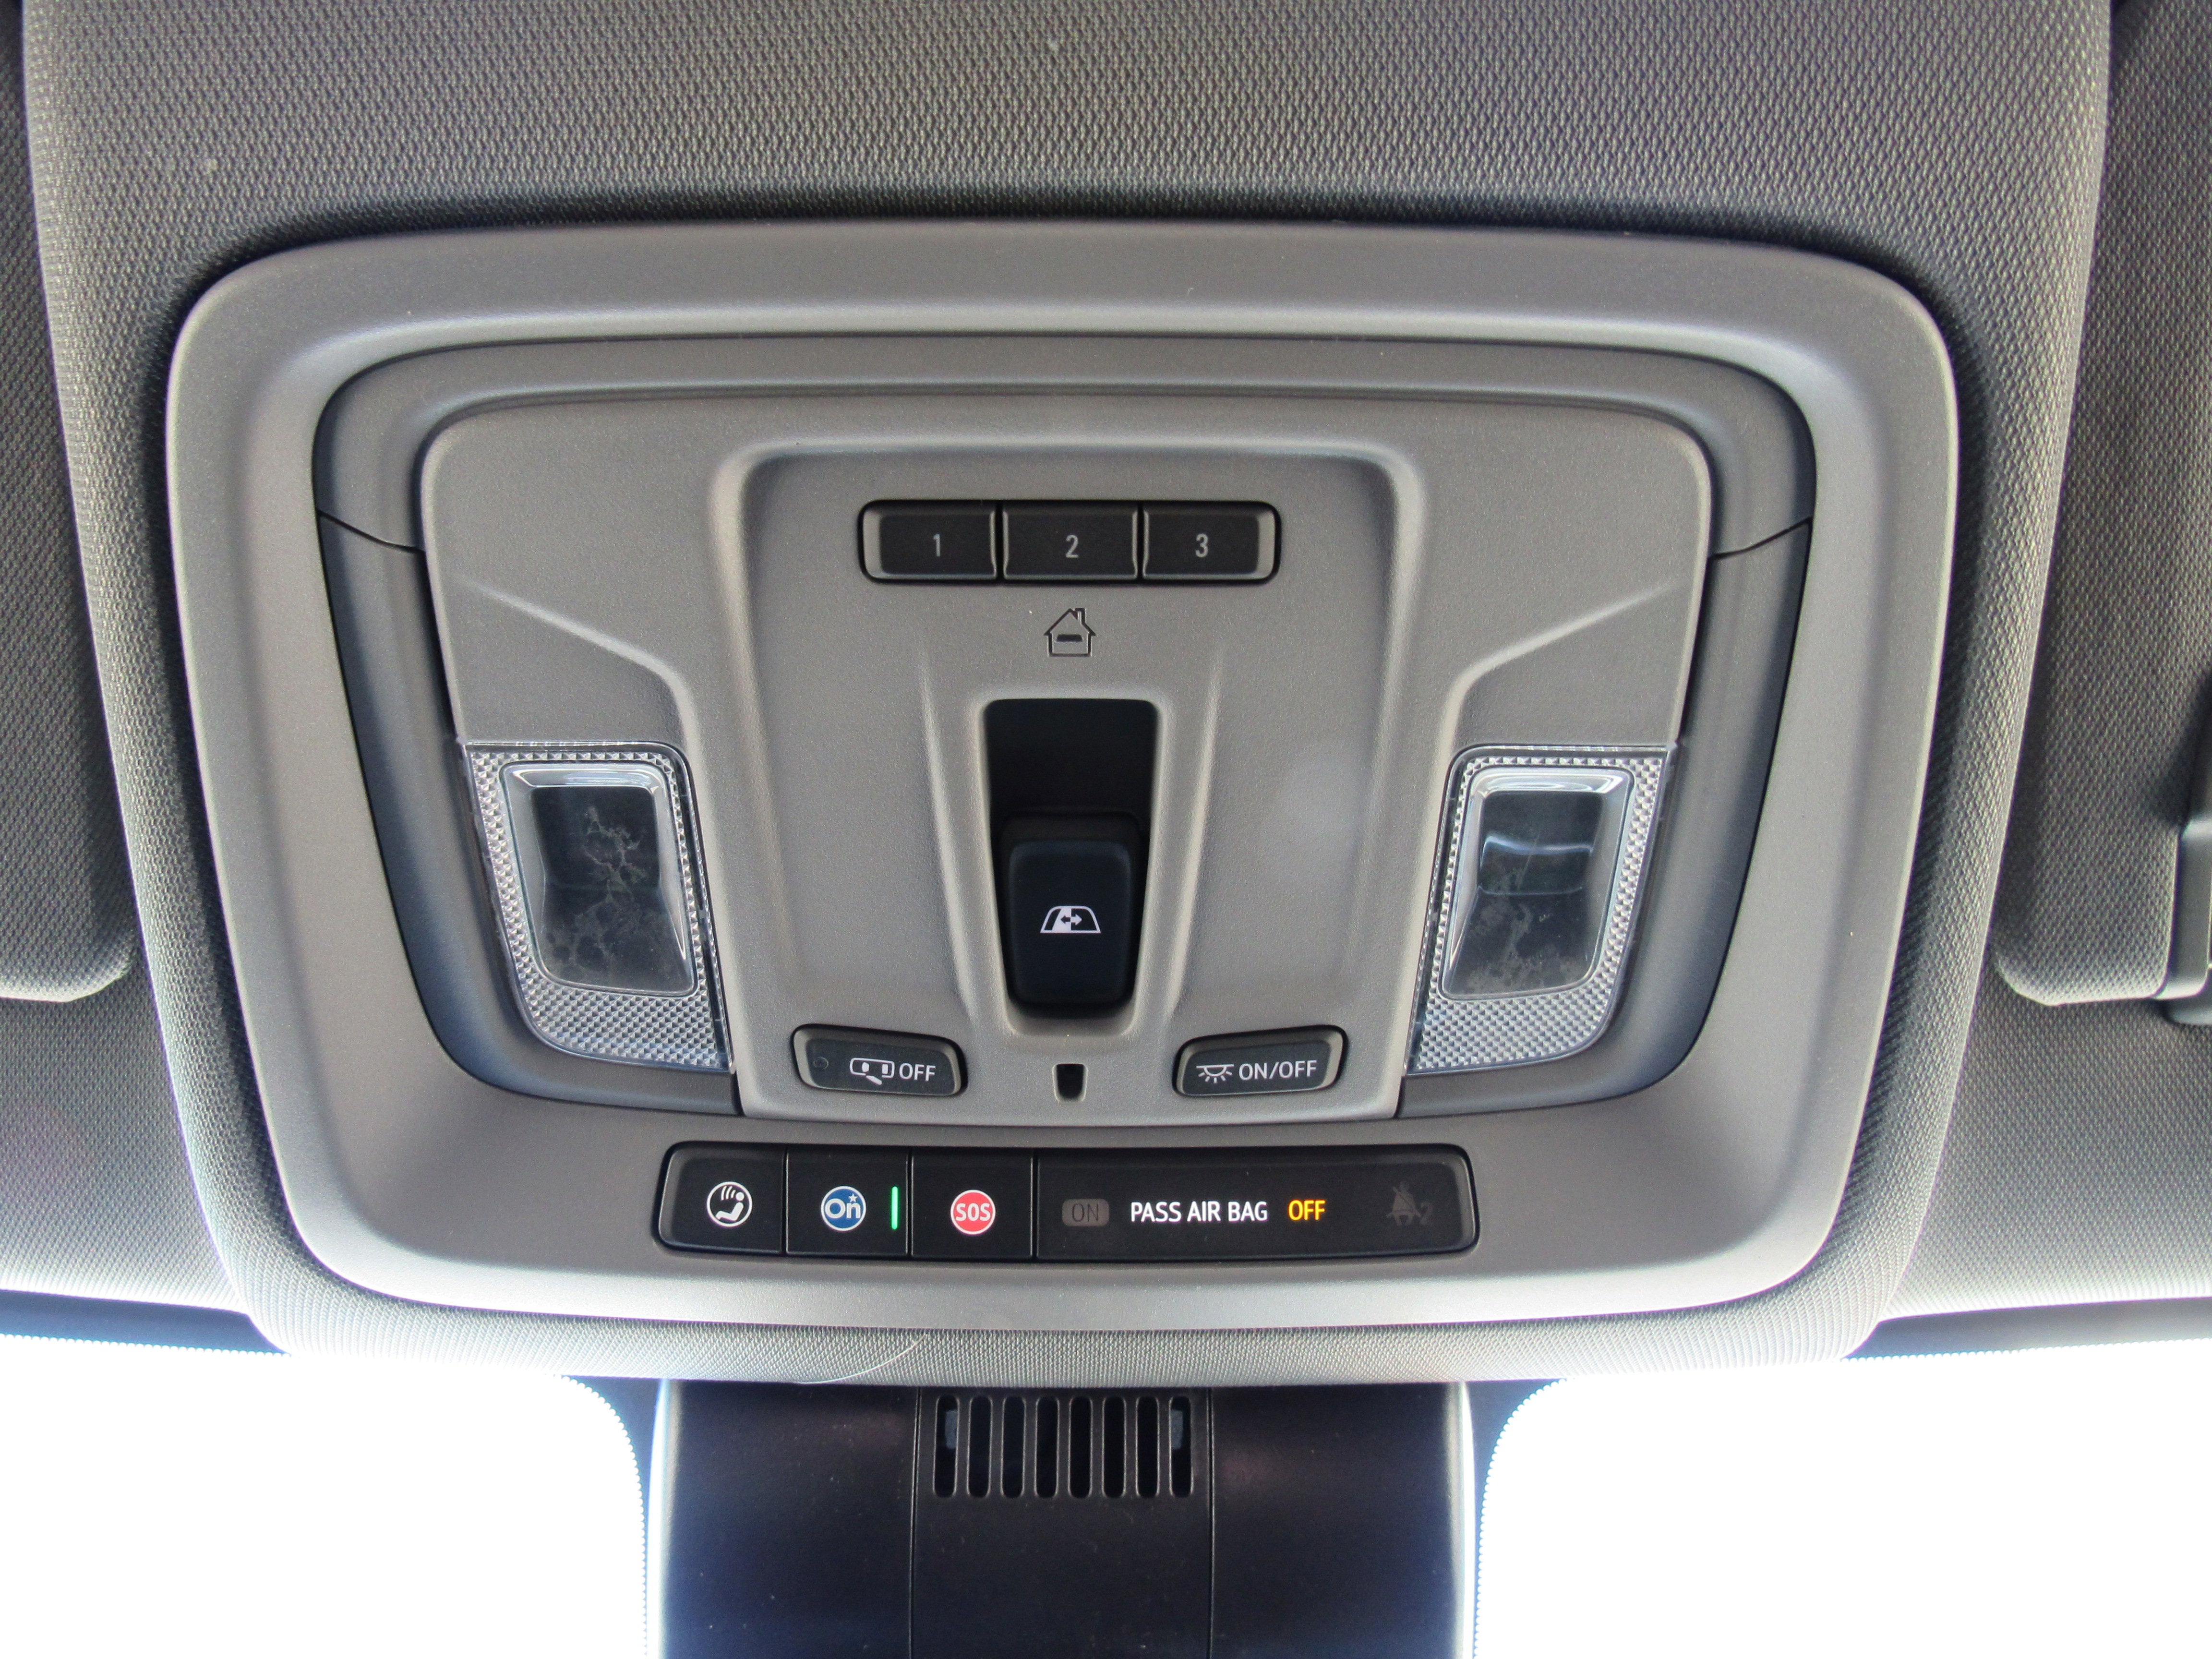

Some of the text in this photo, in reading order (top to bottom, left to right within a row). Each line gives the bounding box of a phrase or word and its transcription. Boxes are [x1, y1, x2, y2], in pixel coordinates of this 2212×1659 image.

[932, 533, 941, 557] 1
[1066, 534, 1079, 559] 2
[1195, 533, 1209, 558] 3
[899, 1062, 936, 1082] OFF
[1238, 1059, 1317, 1081] ON/OFF
[826, 1198, 861, 1219] On
[955, 1202, 991, 1222] SOS
[1071, 1202, 1100, 1223] ON
[1130, 1200, 1326, 1223] PASS AIR BAG OFF
